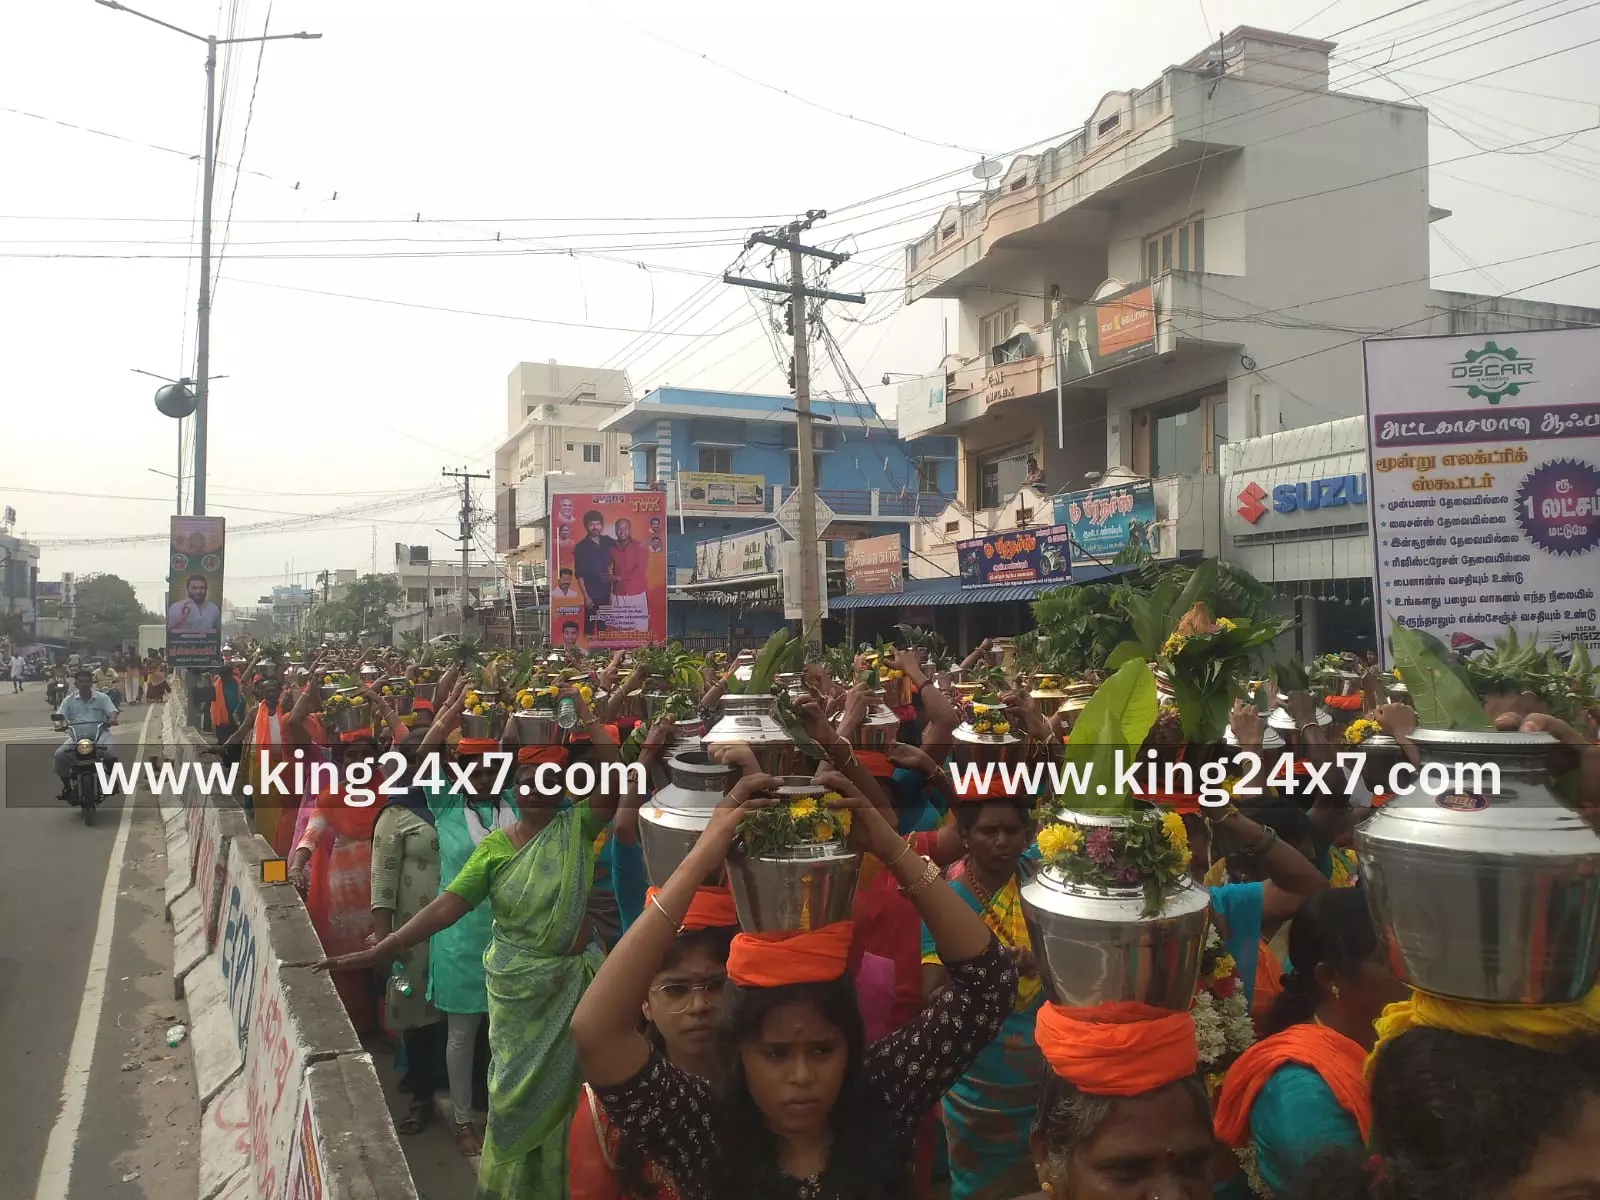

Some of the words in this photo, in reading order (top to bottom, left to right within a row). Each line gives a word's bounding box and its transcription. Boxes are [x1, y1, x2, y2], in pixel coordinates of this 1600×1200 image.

[1451, 362, 1534, 379] OSCAR
[1381, 417, 1531, 440] அட்டகாசமான
[1376, 451, 1436, 472] மூன்று
[1442, 447, 1529, 466] எலக்ட்ரிக்
[1412, 472, 1496, 492] ஸ்கூட்டர்
[1388, 497, 1436, 511] முன்பணம்
[1439, 495, 1509, 509] தேவையில்லை
[1523, 496, 1535, 519] 1
[1389, 516, 1434, 529] லைசன்ஸ்
[1437, 515, 1507, 529] தேவையில்லை
[1549, 523, 1588, 539] மட்டுமே
[1391, 536, 1447, 550] இன்சூரன்ஸ்
[1450, 533, 1519, 548] தேவையில்லை
[1461, 552, 1531, 567] தேவையில்லை
[1393, 576, 1445, 588] பைனான்ஸ்
[1448, 573, 1489, 587] வசதியும்
[1492, 572, 1524, 585] உண்டு
[1444, 594, 1477, 607] பழைய
[1479, 591, 1520, 604] வாகனம்
[1523, 591, 1547, 604] எந்த
[1549, 588, 1594, 602] நிலையில்
[1396, 613, 1456, 628] இருந்தாலும்
[1520, 609, 1561, 624] வசதியும்
[1564, 608, 1597, 621] உண்டு
